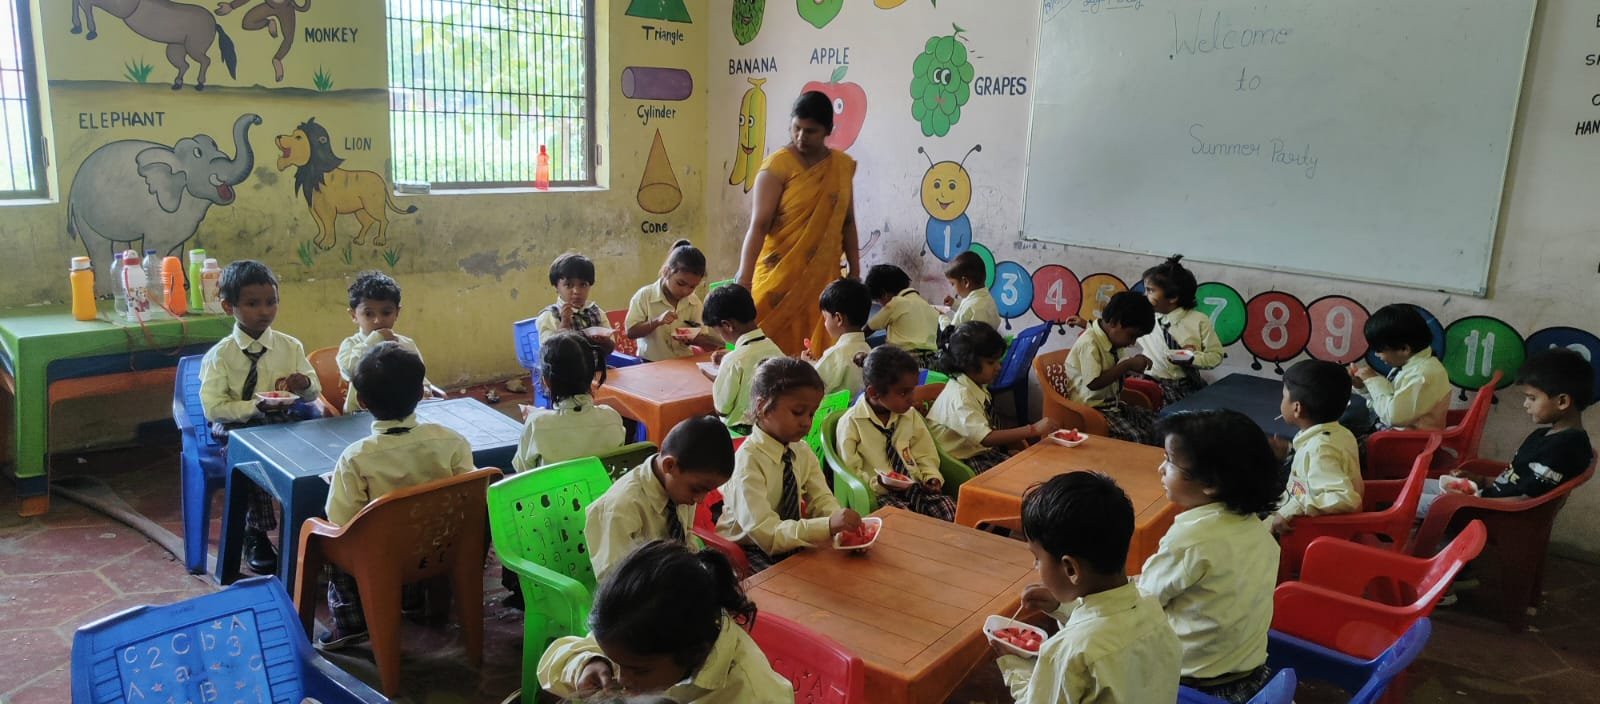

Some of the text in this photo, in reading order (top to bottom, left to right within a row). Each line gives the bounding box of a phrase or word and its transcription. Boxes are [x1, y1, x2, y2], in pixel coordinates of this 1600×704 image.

[304, 27, 359, 44] MONKEY
[641, 25, 685, 45] Triangle
[1169, 8, 1290, 55] Welcome
[728, 56, 778, 75] BANANA
[810, 47, 850, 65] APPLE
[974, 76, 1027, 96] GRAPES
[1234, 67, 1261, 91] to
[79, 111, 165, 129] ELEPHANT
[637, 104, 677, 126] Cylinder
[344, 136, 372, 151] LION
[1189, 123, 1261, 155] Summer
[641, 220, 668, 234] Cone
[943, 225, 951, 258] 1
[1001, 273, 1018, 306] 3
[1045, 278, 1067, 312] 4
[1203, 297, 1228, 329] 7
[1261, 301, 1290, 349] 8
[1325, 305, 1353, 357] 9
[1464, 329, 1495, 377] 11
